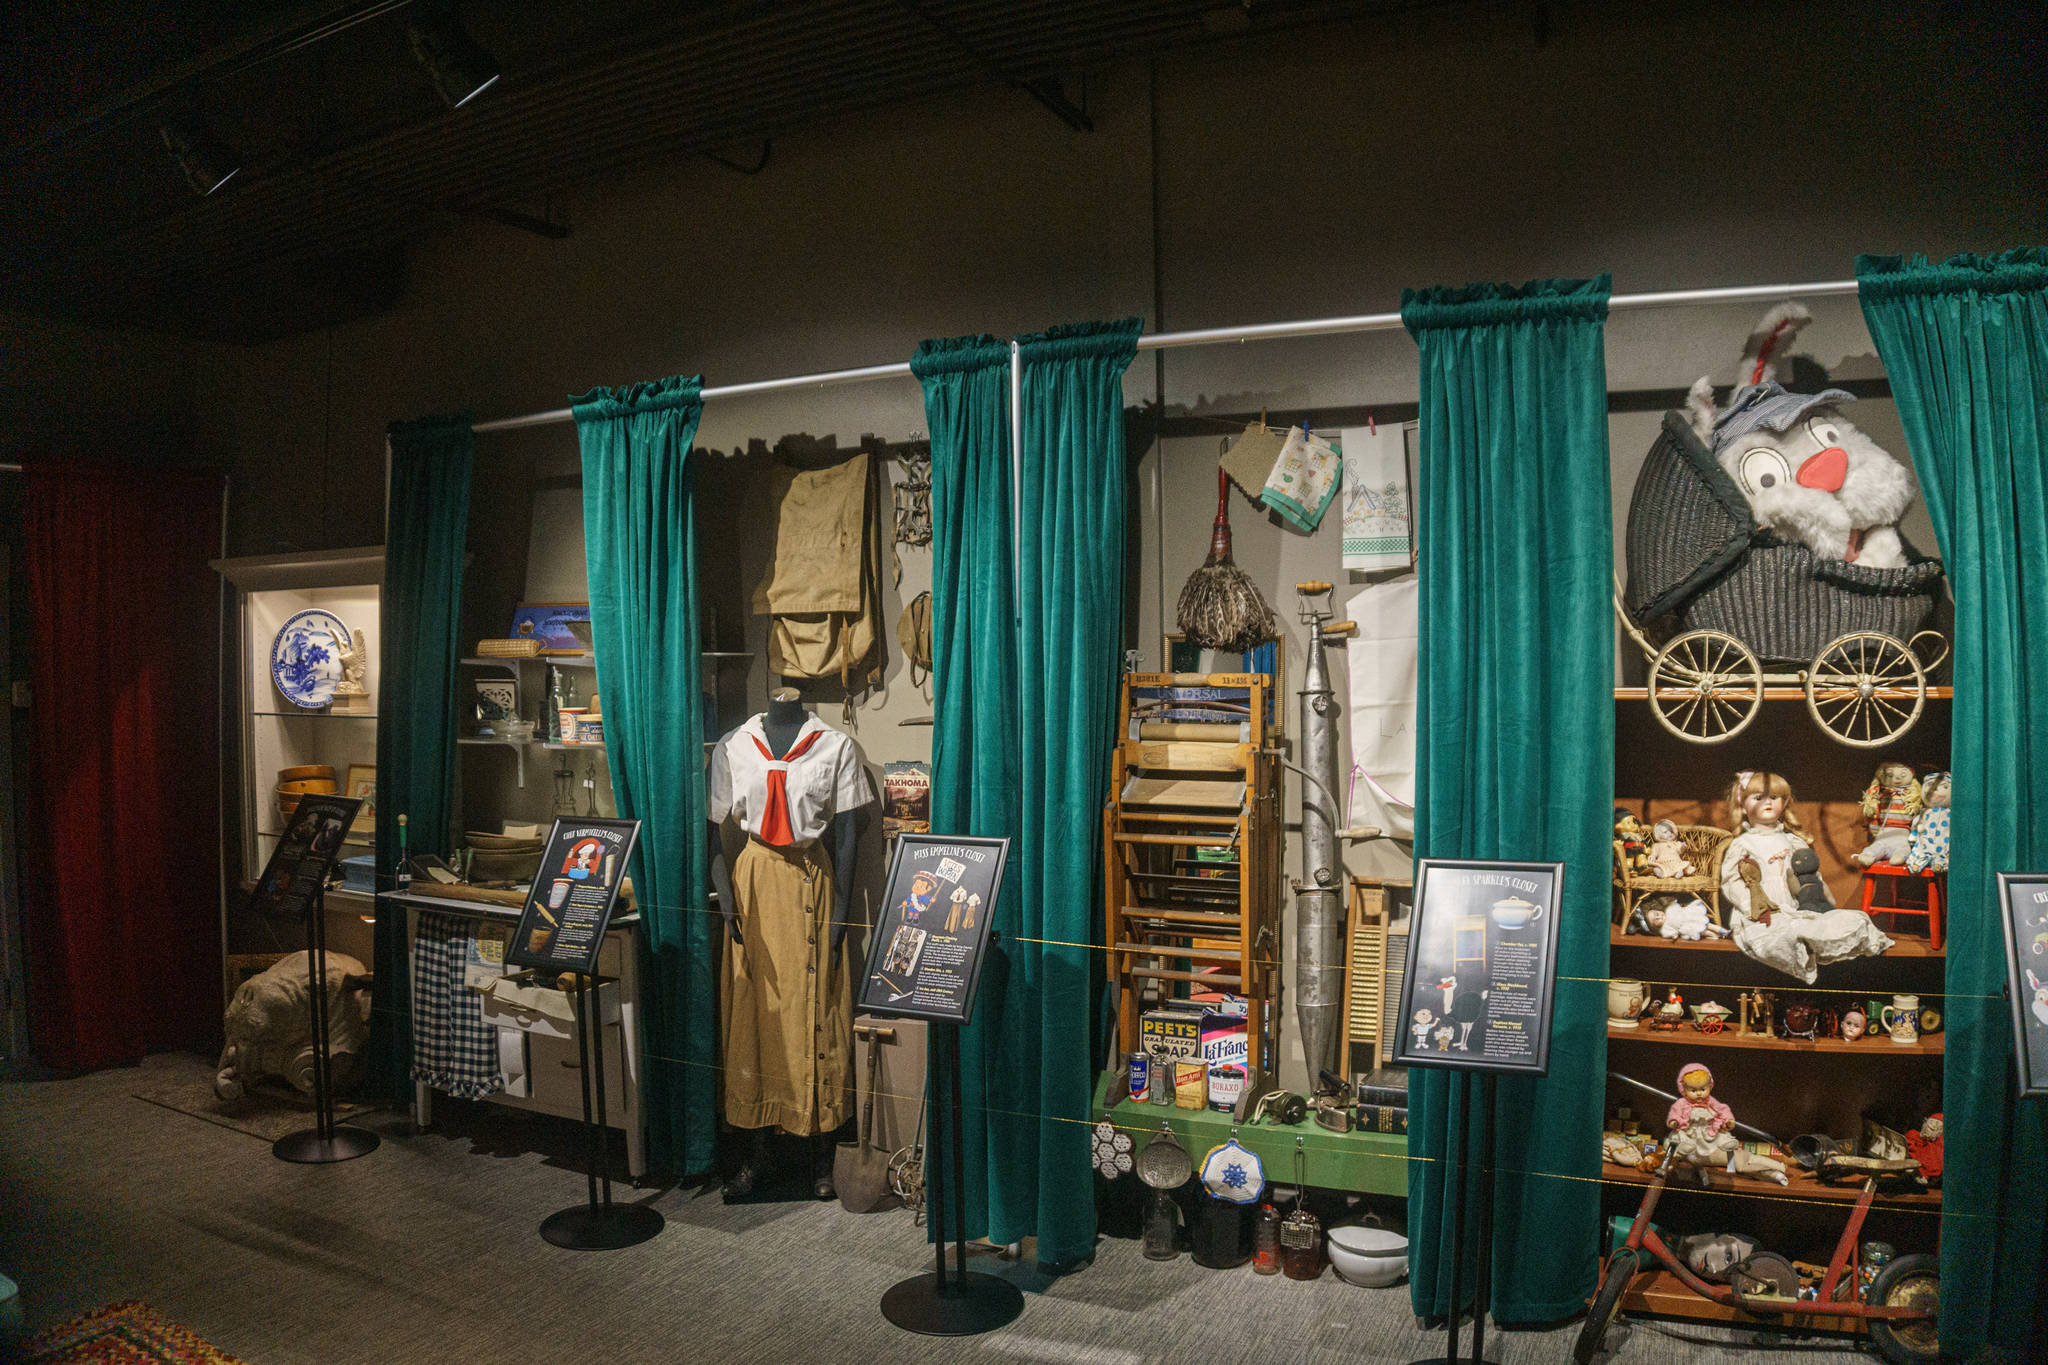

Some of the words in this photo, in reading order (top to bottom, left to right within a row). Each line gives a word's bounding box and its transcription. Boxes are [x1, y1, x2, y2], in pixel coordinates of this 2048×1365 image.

[1157, 689, 1226, 701] UNIVERSAL
[884, 778, 929, 787] TAKHOMA
[913, 848, 929, 860] MISS
[930, 846, 965, 858] EMMELINE'S
[965, 849, 986, 864] CLOSET
[1472, 874, 1511, 888] SPARKLE'S
[1512, 878, 1538, 894] CLOSET
[1143, 1021, 1197, 1038] PEET'S
[1144, 1036, 1196, 1047] GRAULATED
[1176, 1073, 1189, 1083] Bon
[1188, 1071, 1202, 1081] Ami
[1211, 1081, 1239, 1092] BORAXO
